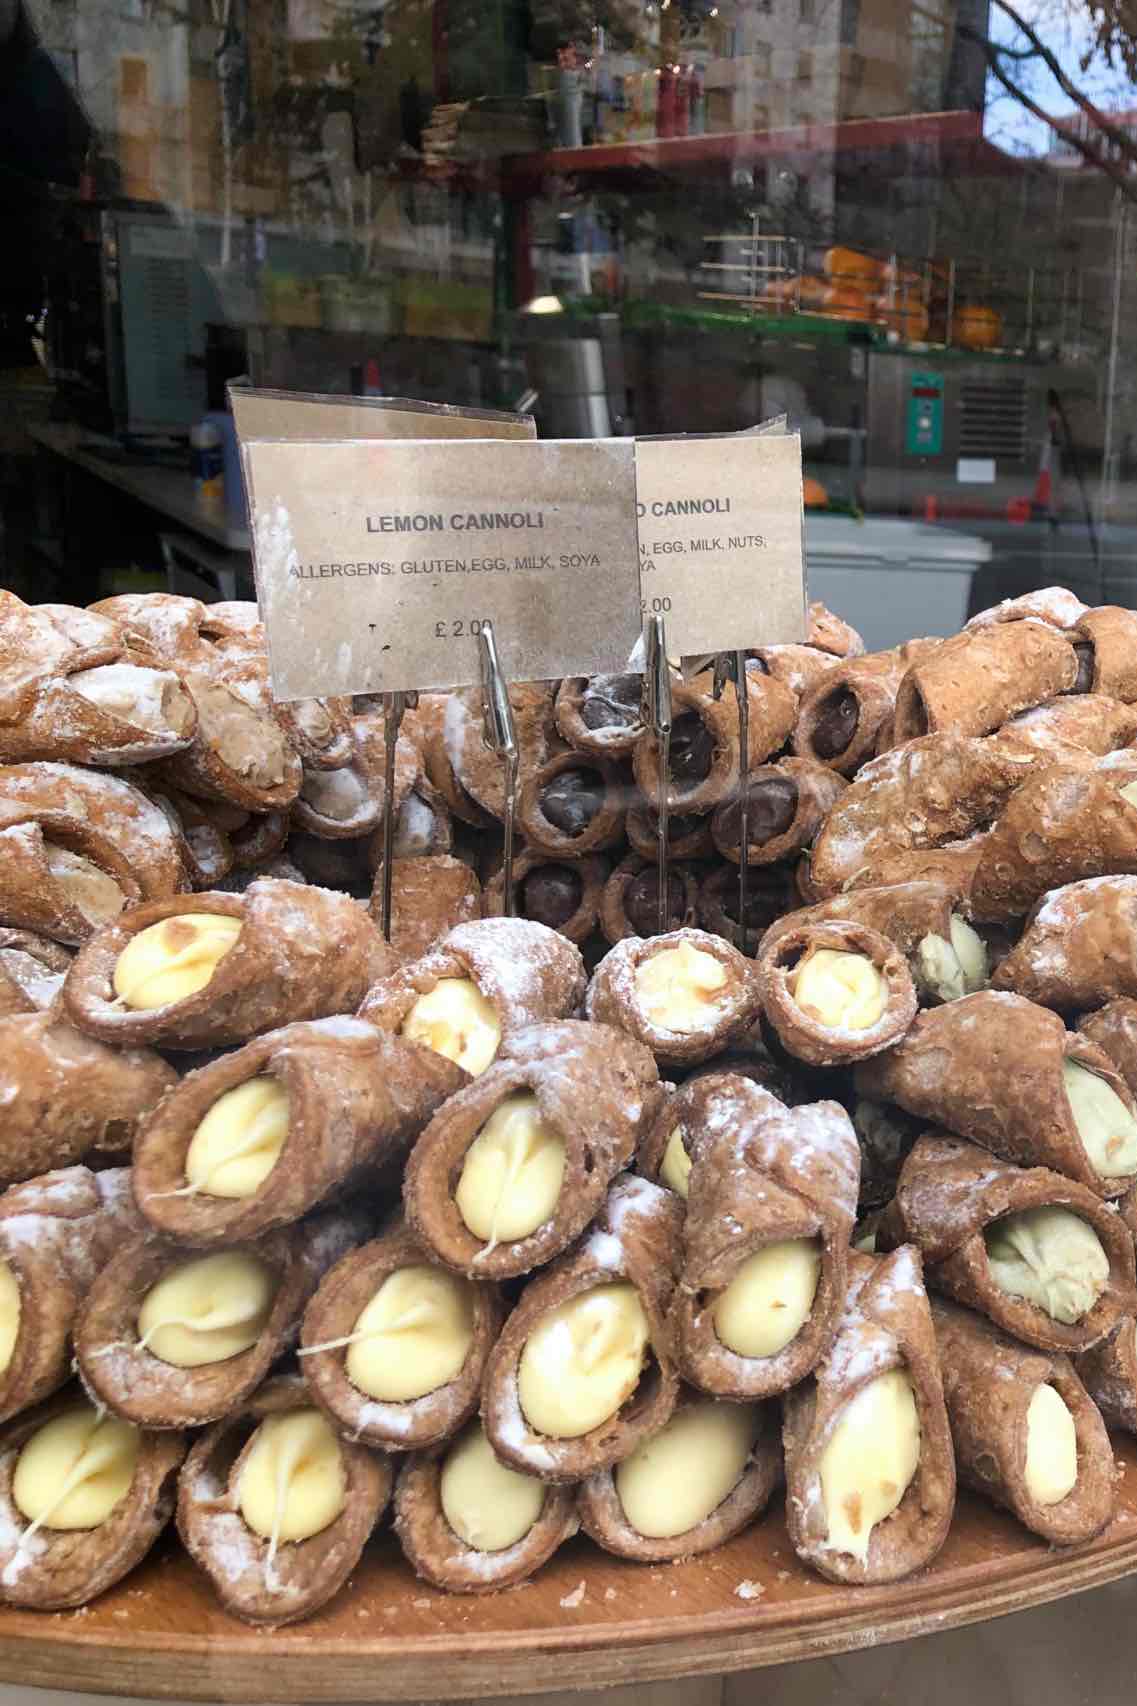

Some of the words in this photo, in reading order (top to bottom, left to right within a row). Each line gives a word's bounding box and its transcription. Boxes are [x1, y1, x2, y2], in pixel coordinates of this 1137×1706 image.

[651, 497, 731, 518] CANNOLI
[366, 514, 444, 533] LEMON
[450, 511, 544, 531] CANNOLI
[653, 541, 687, 555] EGG,
[690, 538, 725, 552] MILK,
[290, 560, 396, 579] ALLERGENS:
[515, 555, 555, 571] MILK,
[559, 552, 600, 568] SOYA
[435, 622, 447, 638] £
